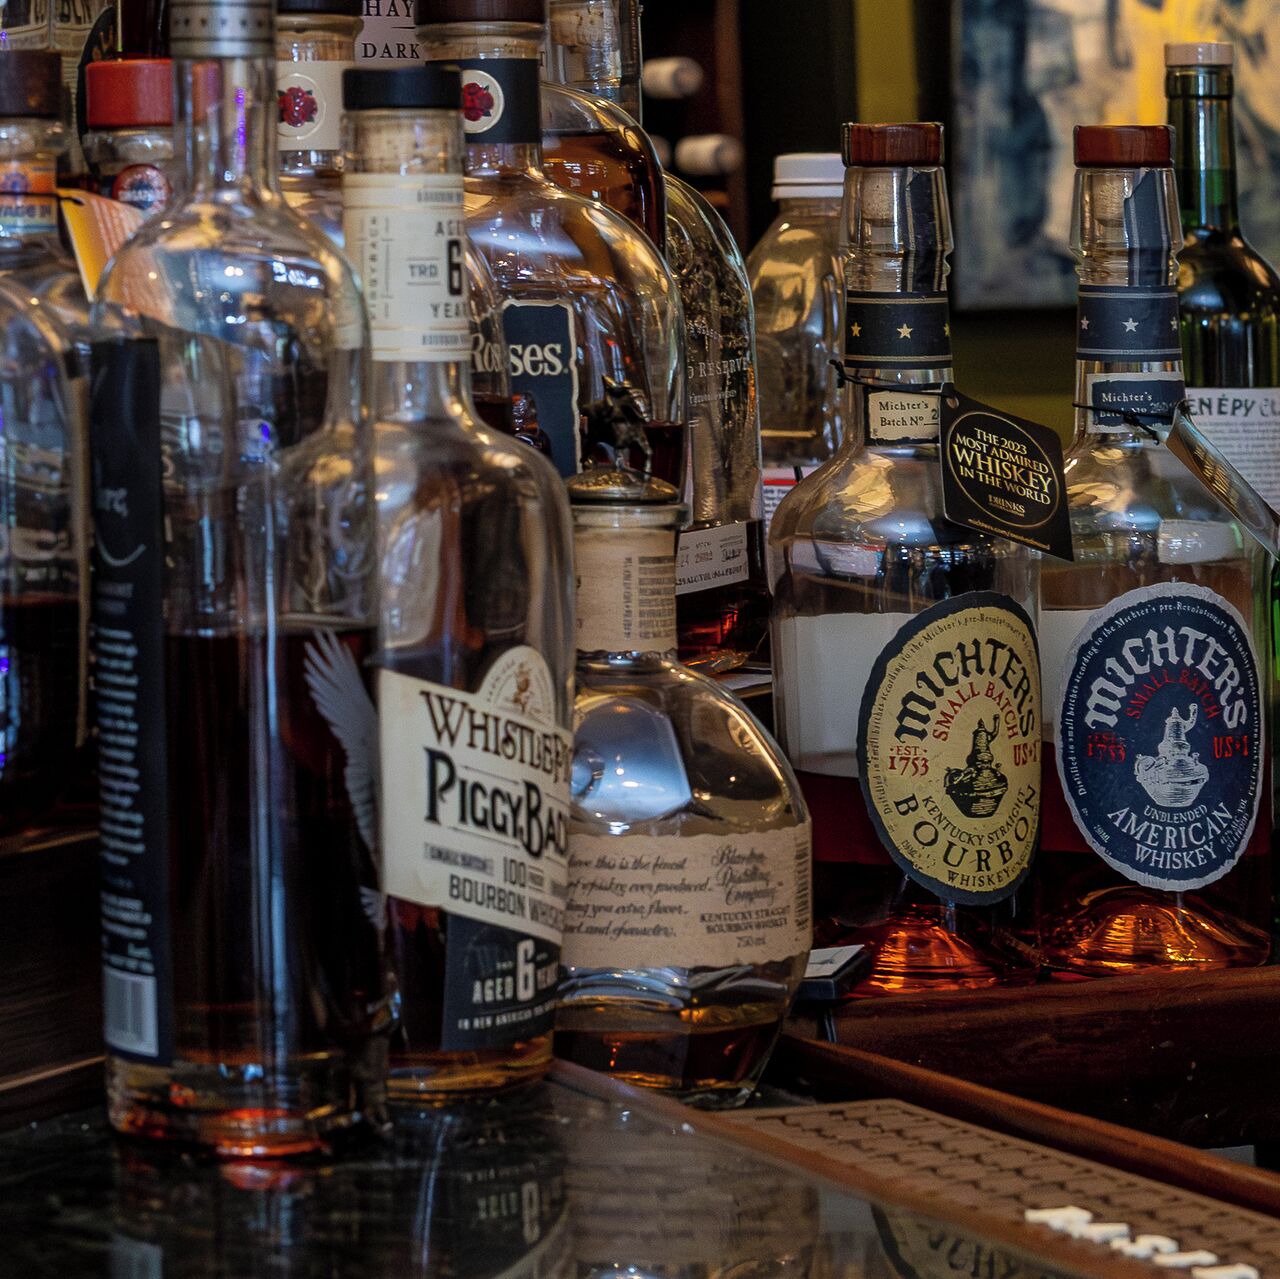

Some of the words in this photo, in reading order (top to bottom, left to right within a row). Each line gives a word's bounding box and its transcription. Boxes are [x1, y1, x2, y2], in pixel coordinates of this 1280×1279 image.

[361, 42, 421, 60] DARK
[698, 357, 751, 378] RESERVE
[879, 400, 929, 412] Michter's
[1101, 391, 1153, 403] Michter's
[880, 416, 907, 427] Batch
[956, 432, 989, 454] MOST
[990, 446, 1049, 474] ADMIRED
[974, 427, 1000, 446] THE
[1000, 437, 1028, 455] 2023
[952, 443, 1053, 494] WHISKEY
[959, 464, 975, 479] IN
[975, 470, 1002, 489] THE
[1004, 480, 1051, 505] WORLD
[988, 494, 1025, 514] DRINKS
[894, 637, 1036, 744] MICHTER'S
[1084, 625, 1248, 730] MICHTER'S
[1124, 669, 1177, 719] SMALL
[1179, 668, 1220, 719] BATCH
[932, 681, 980, 741] SMALL
[984, 680, 1019, 740] BATCH
[888, 755, 930, 777] 1753
[893, 784, 1037, 873] BOURBON
[922, 795, 985, 846] KENTUCKY
[987, 787, 1026, 845] STRAIGHT
[1106, 801, 1233, 849] AMERICAN
[1143, 803, 1208, 825] UNBLENDED
[1135, 841, 1217, 870] WHISKEY
[947, 866, 1011, 888] WHISKEY
[449, 873, 526, 919] BOURBON
[516, 938, 536, 1002] 6
[472, 975, 514, 1005] AGED
